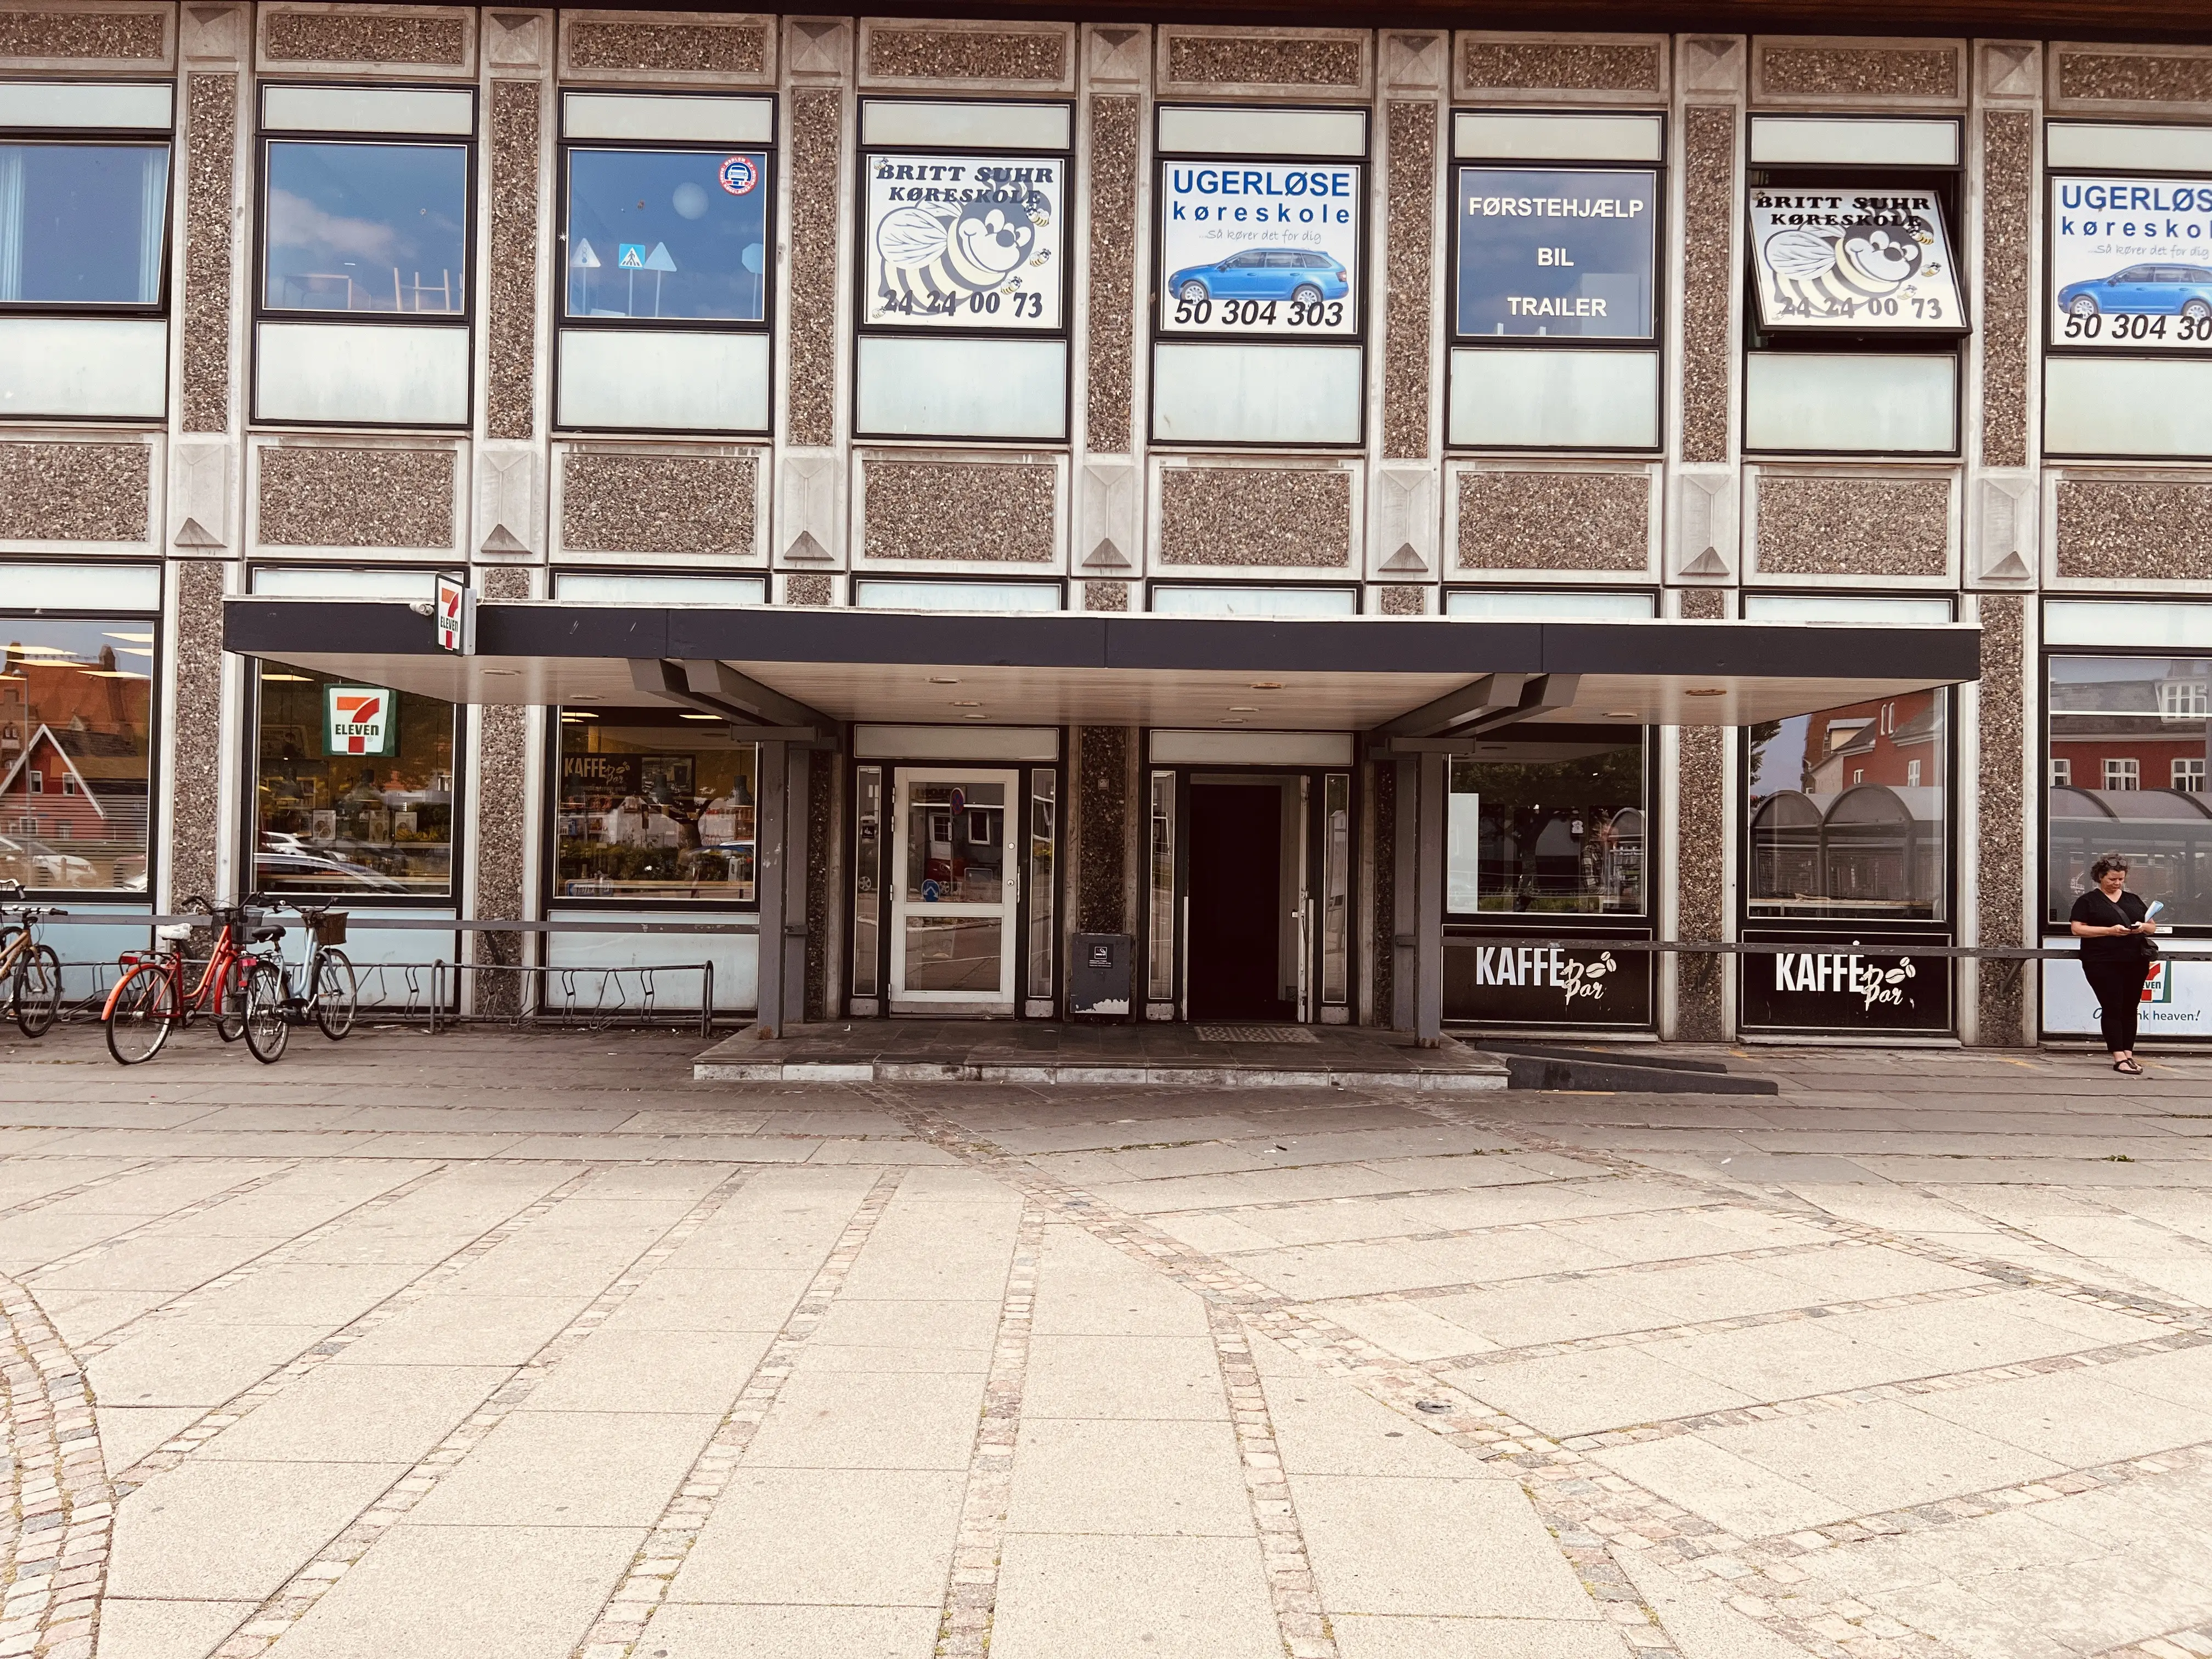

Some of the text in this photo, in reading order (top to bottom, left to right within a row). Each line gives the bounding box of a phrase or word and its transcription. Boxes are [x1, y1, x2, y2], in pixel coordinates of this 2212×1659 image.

[876, 165, 1053, 183] BRITT SUHR
[1174, 170, 1350, 196] UGERLØSE
[889, 187, 1041, 204] KØRESKOLE
[1755, 196, 1931, 210] BRITT SUHR
[1173, 201, 1349, 223] køreskole
[1469, 197, 1644, 218] FØRSTEHJÆLP
[1770, 213, 1922, 227] KØRESKOLE
[1227, 229, 1259, 241] kører
[1262, 229, 1278, 240] det
[1282, 229, 1299, 244] for
[1302, 230, 1322, 245] dig
[1538, 247, 1574, 266] BIL
[2116, 245, 2147, 256] kører
[2150, 245, 2166, 255] det
[2170, 245, 2187, 258] for
[2190, 246, 2209, 259] dig
[883, 289, 1042, 318] 24 24 00 73
[1175, 299, 1344, 326] 50 304 303
[1507, 297, 1607, 317] TRAILER
[1780, 297, 1943, 319] 24 24 00 73
[2064, 313, 2102, 338] 50
[2112, 314, 2166, 340] 304
[565, 758, 606, 777] KAFFE
[1476, 946, 1565, 986] KAFFE
[1776, 953, 1864, 992] KAFFE
[1559, 958, 1604, 1006] Bar
[1859, 964, 1903, 1011] Bar
[2153, 1010, 2200, 1021] heaven!
